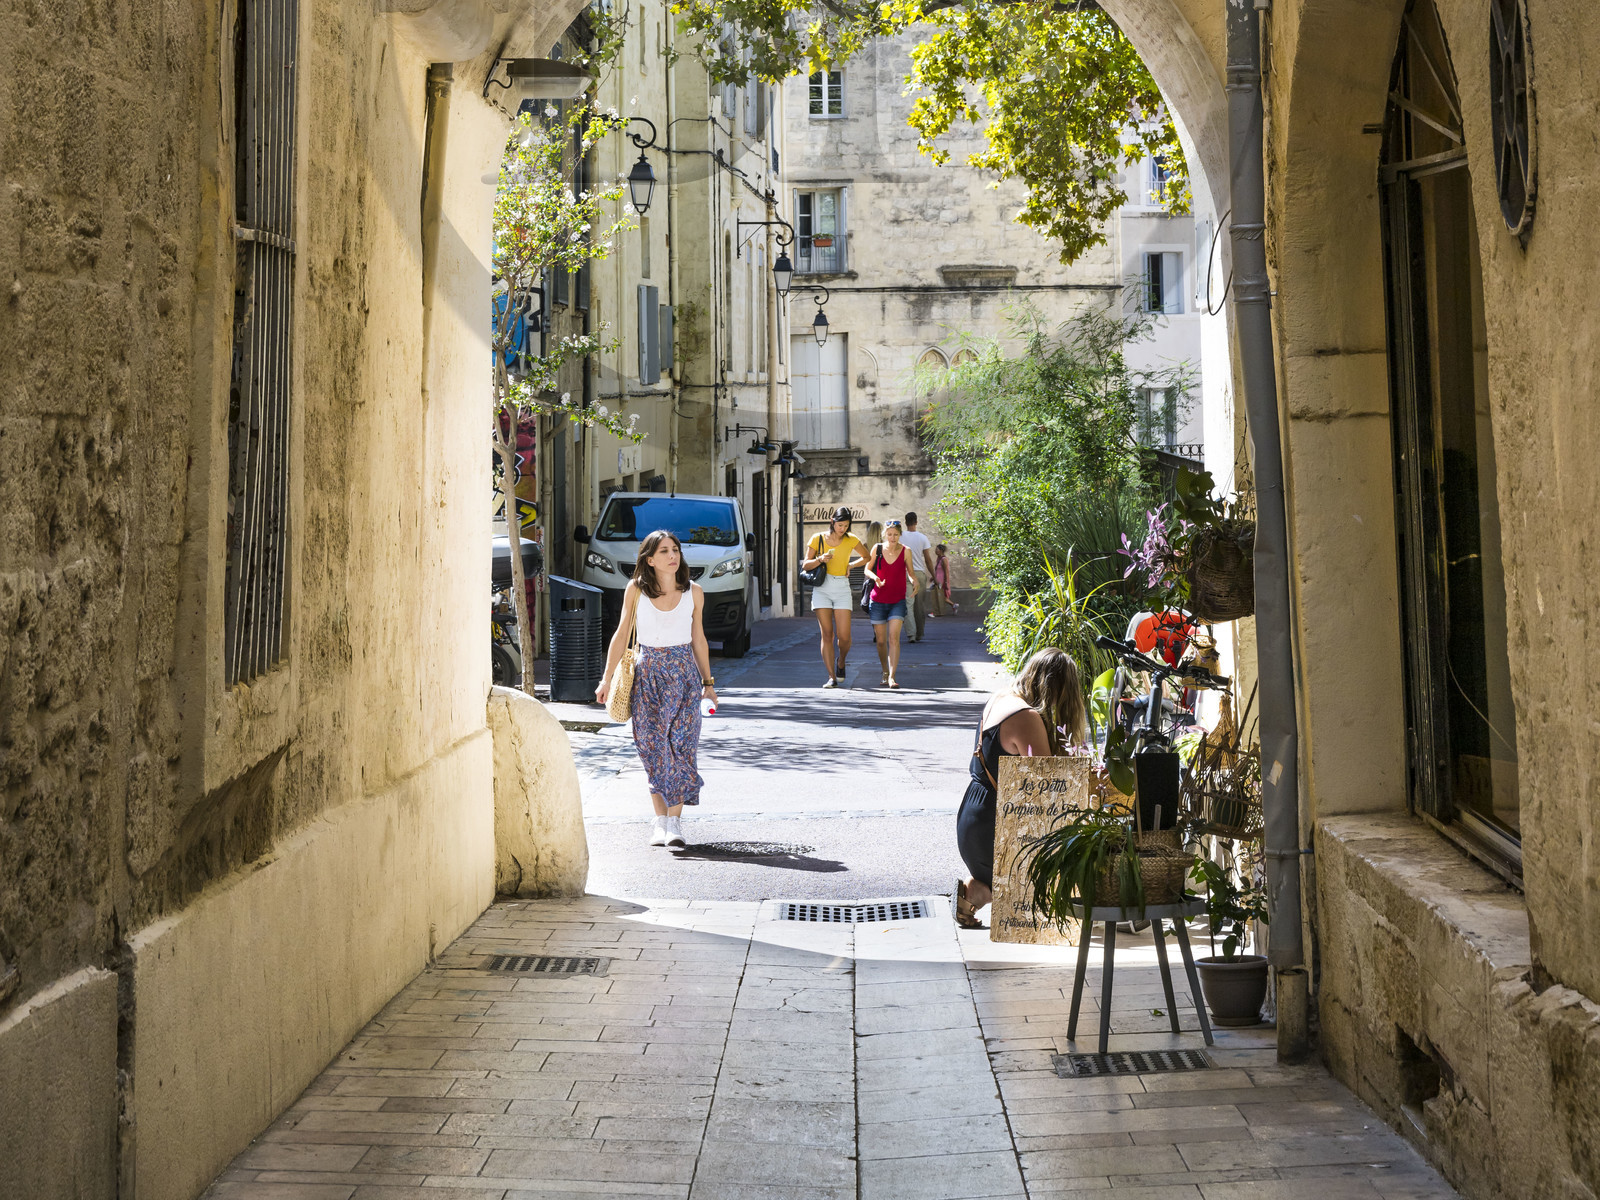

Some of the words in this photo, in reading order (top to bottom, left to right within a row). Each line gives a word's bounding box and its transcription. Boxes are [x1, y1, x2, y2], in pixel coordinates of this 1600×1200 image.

[814, 506, 865, 520] Valno
[1018, 778, 1035, 796] Les
[1038, 778, 1067, 795] Petits
[1003, 801, 1044, 819] Papiers
[1046, 802, 1058, 816] de
